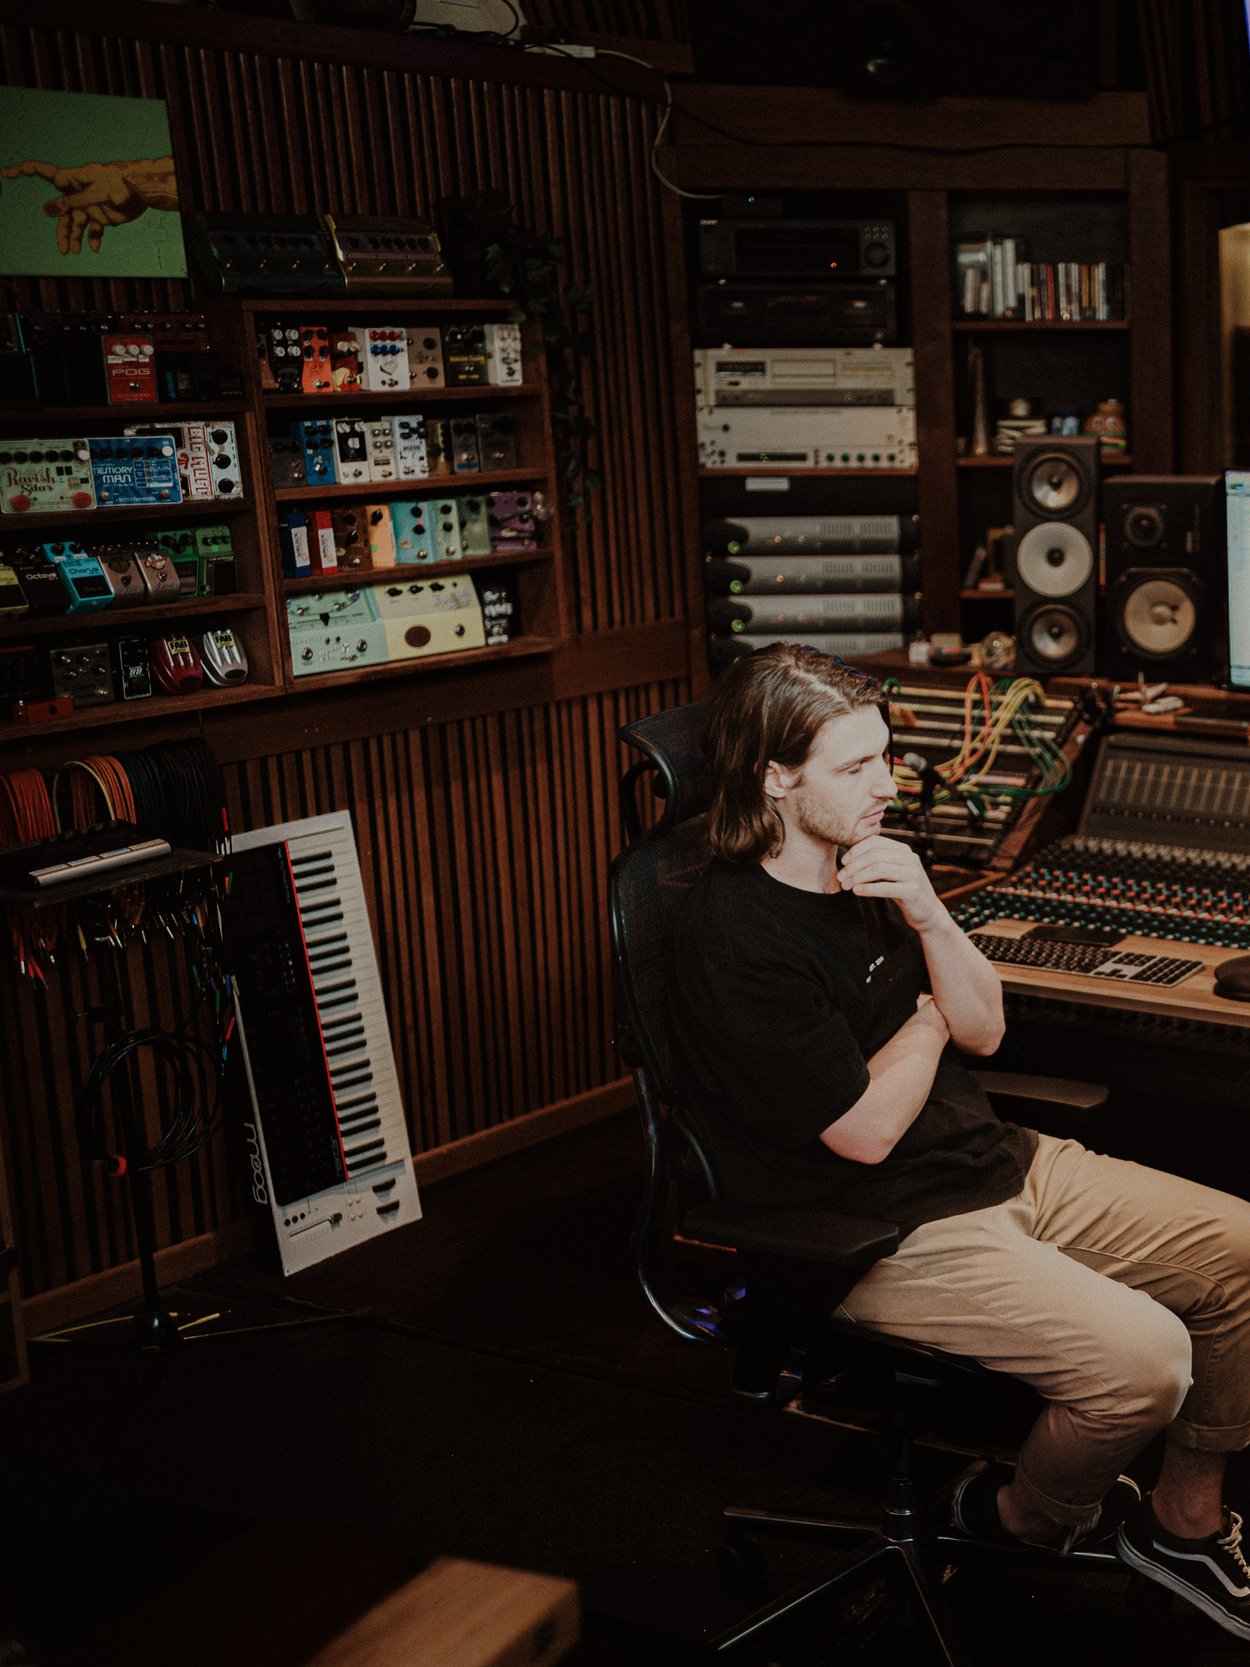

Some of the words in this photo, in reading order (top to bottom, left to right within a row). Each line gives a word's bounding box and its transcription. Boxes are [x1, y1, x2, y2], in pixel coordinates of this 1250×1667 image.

[112, 368, 151, 377] POG
[4, 467, 56, 487] Ravish
[102, 474, 132, 484] MAN
[21, 484, 55, 496] Sitar
[214, 634, 232, 644] FAB
[169, 641, 188, 650] FAB
[244, 1122, 269, 1205] moog
